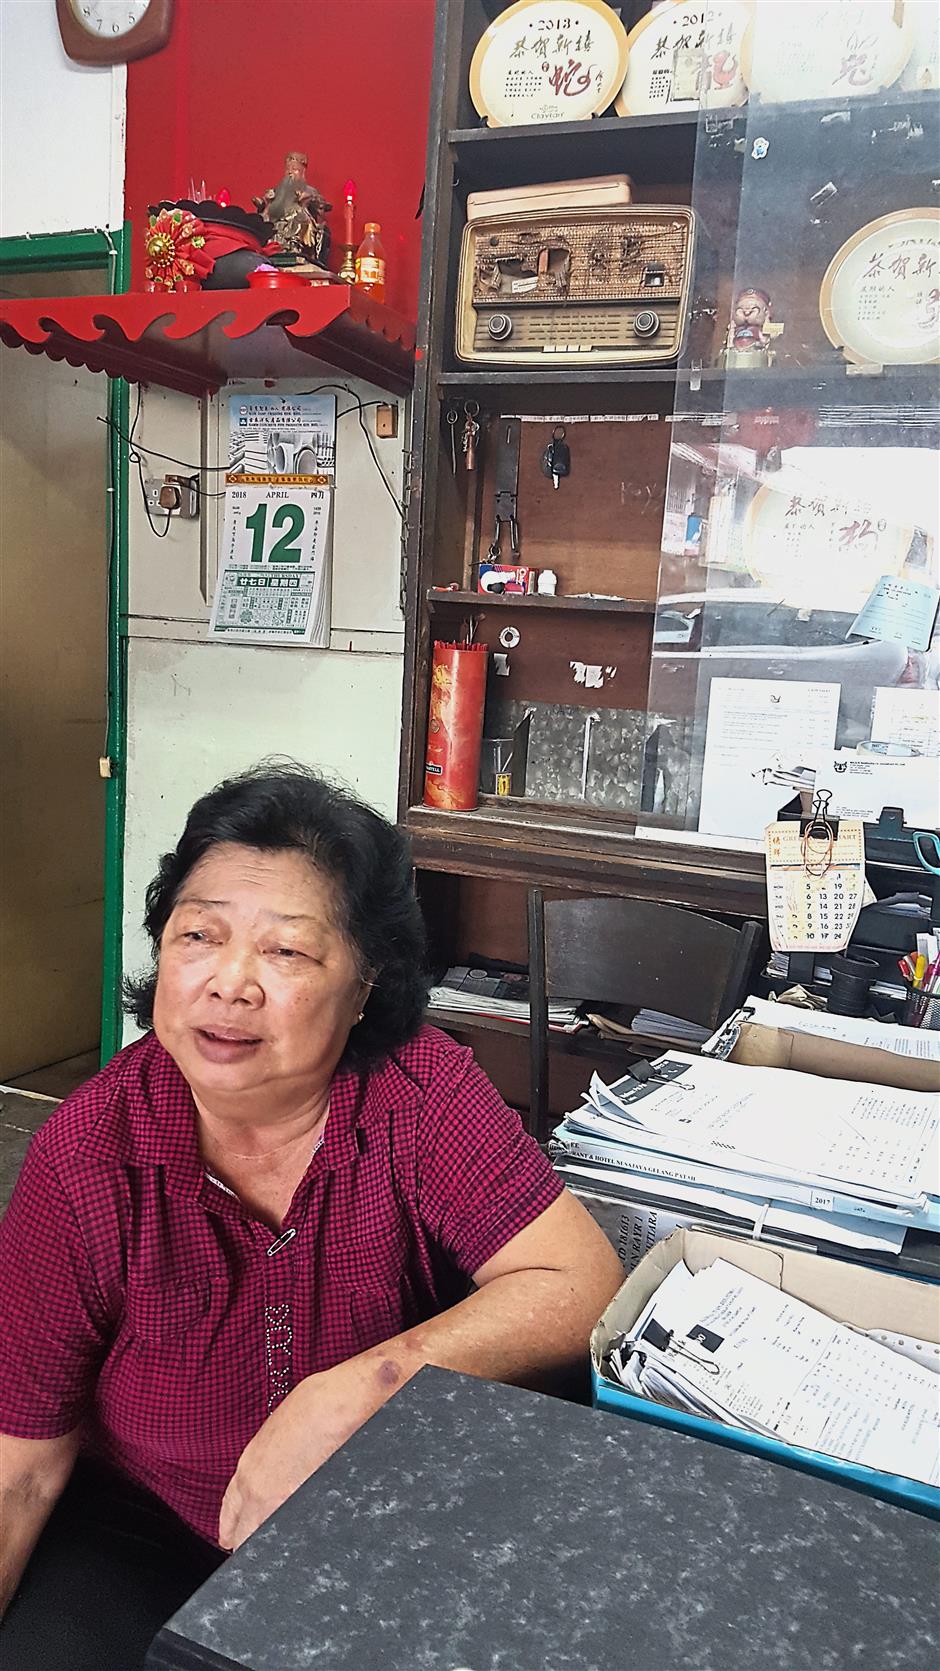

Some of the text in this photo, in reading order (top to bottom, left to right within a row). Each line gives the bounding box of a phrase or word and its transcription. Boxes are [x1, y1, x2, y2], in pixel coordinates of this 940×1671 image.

[232, 491, 247, 499] 2018
[266, 491, 289, 499] APRIL
[246, 503, 305, 563] 12
[806, 932, 815, 940] 10
[595, 1155, 614, 1165] HOTEL
[815, 1197, 831, 1205] 2017
